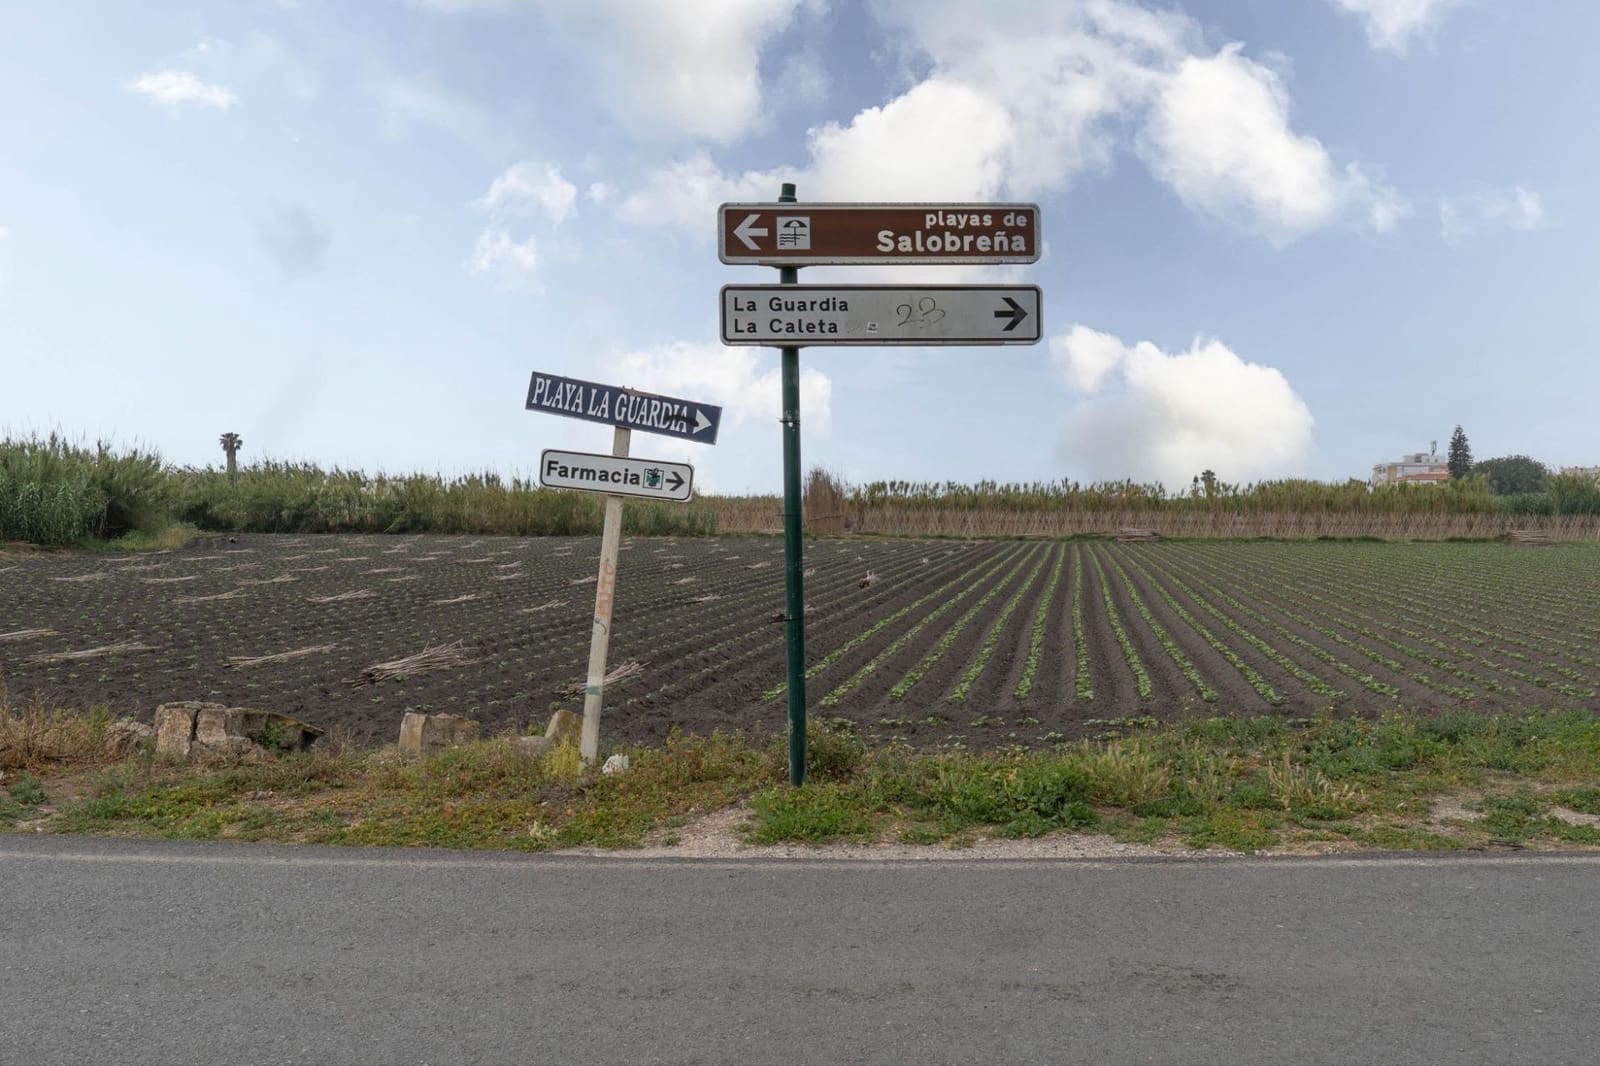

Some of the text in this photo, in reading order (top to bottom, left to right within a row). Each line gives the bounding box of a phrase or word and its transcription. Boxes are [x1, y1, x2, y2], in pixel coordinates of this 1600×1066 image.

[925, 211, 1027, 229] playas de
[876, 230, 1026, 252] Salobreña
[733, 296, 849, 312] La Guardia
[733, 318, 839, 334] La Caleta
[531, 377, 688, 433] PLAYA LA GUARDIA
[546, 460, 640, 486] Farmacia
